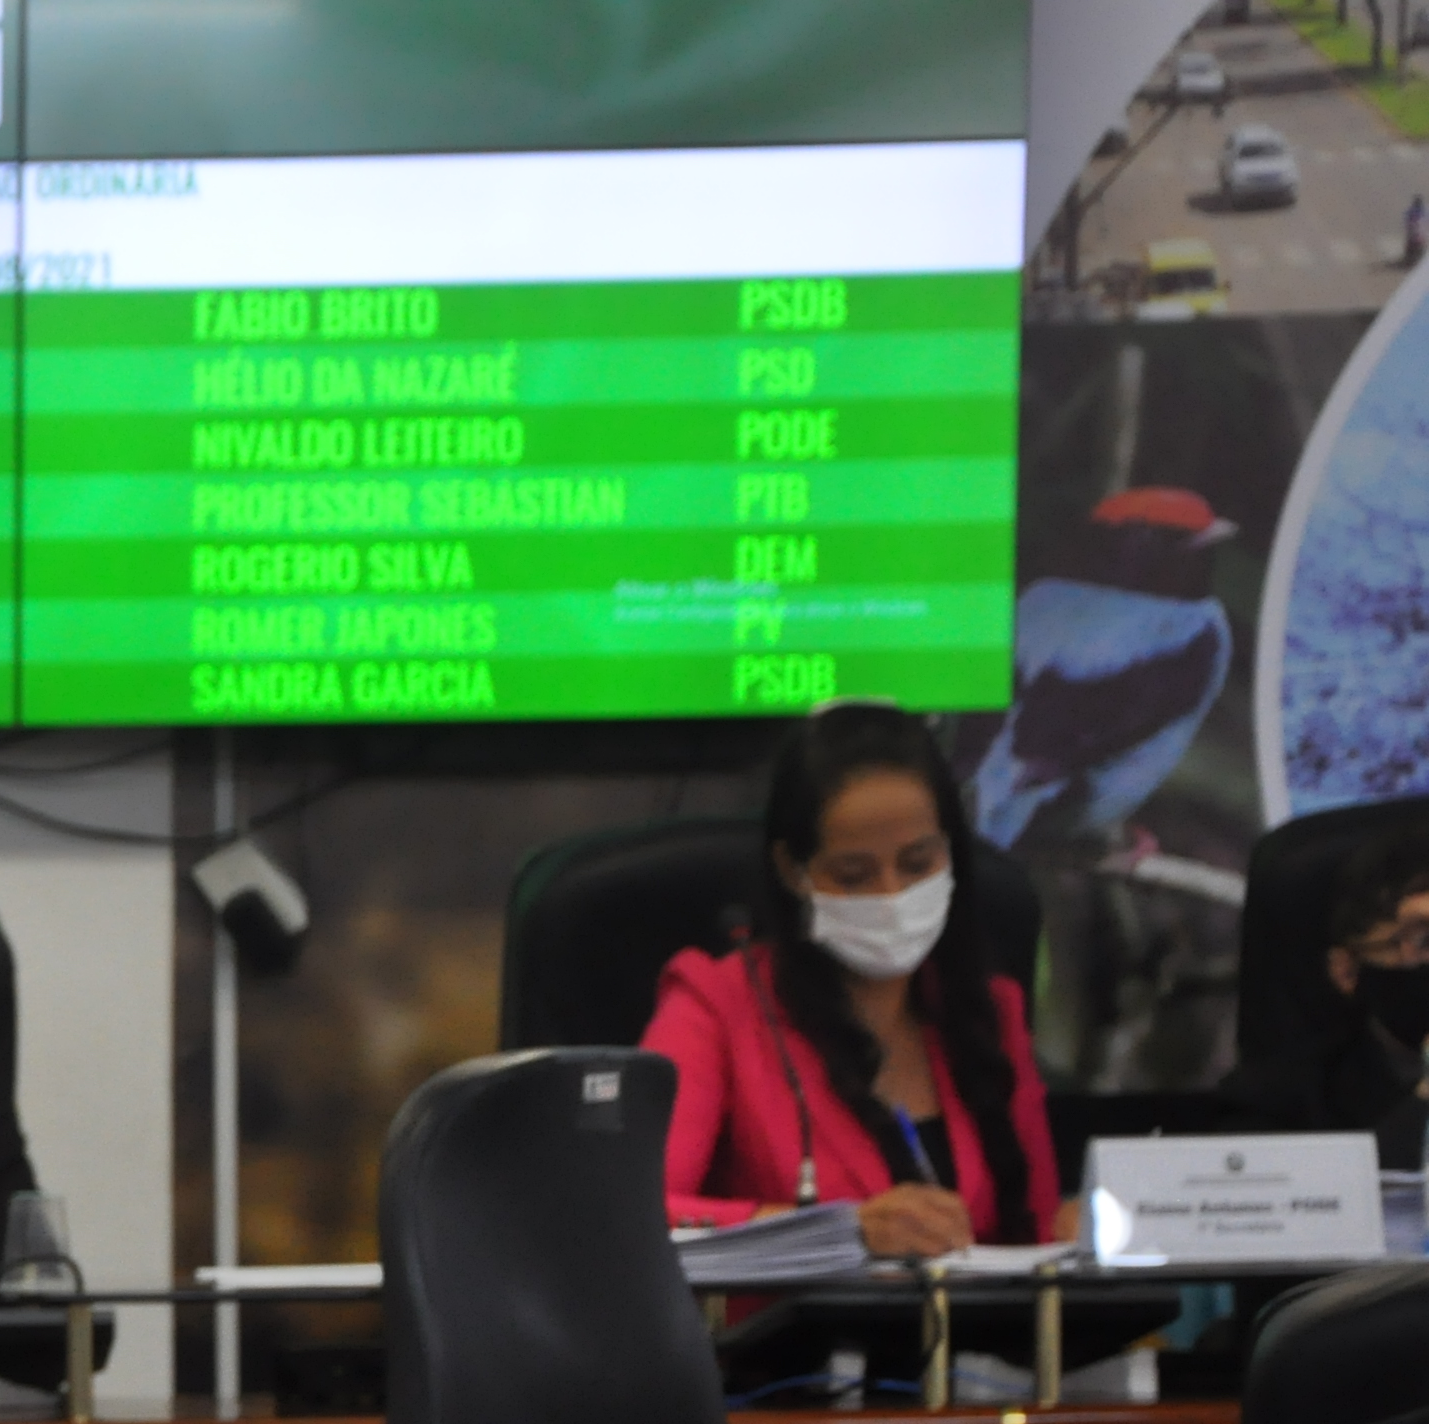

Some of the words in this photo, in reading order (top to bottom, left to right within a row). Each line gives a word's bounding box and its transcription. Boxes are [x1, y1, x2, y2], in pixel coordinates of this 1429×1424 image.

[320, 288, 439, 337] BRITO
[738, 279, 849, 330] PSDB
[191, 349, 304, 406] HÉLIO
[312, 357, 365, 404] DA
[373, 341, 519, 403] NAZARÉ
[737, 348, 816, 397] PSD
[192, 420, 355, 470] NIVALDO
[362, 417, 524, 466] LEITEIRO
[736, 409, 838, 458] PODE
[191, 481, 410, 532] PROFESSOR
[419, 476, 627, 528] SEBASTIAN
[191, 544, 359, 593] ROGERIO
[368, 541, 475, 589] SILVA
[734, 535, 819, 584] DEM
[191, 606, 327, 656] ROMER
[189, 663, 343, 714] SANDRA
[351, 660, 496, 710] GARCIA
[734, 654, 838, 704] PSDB
